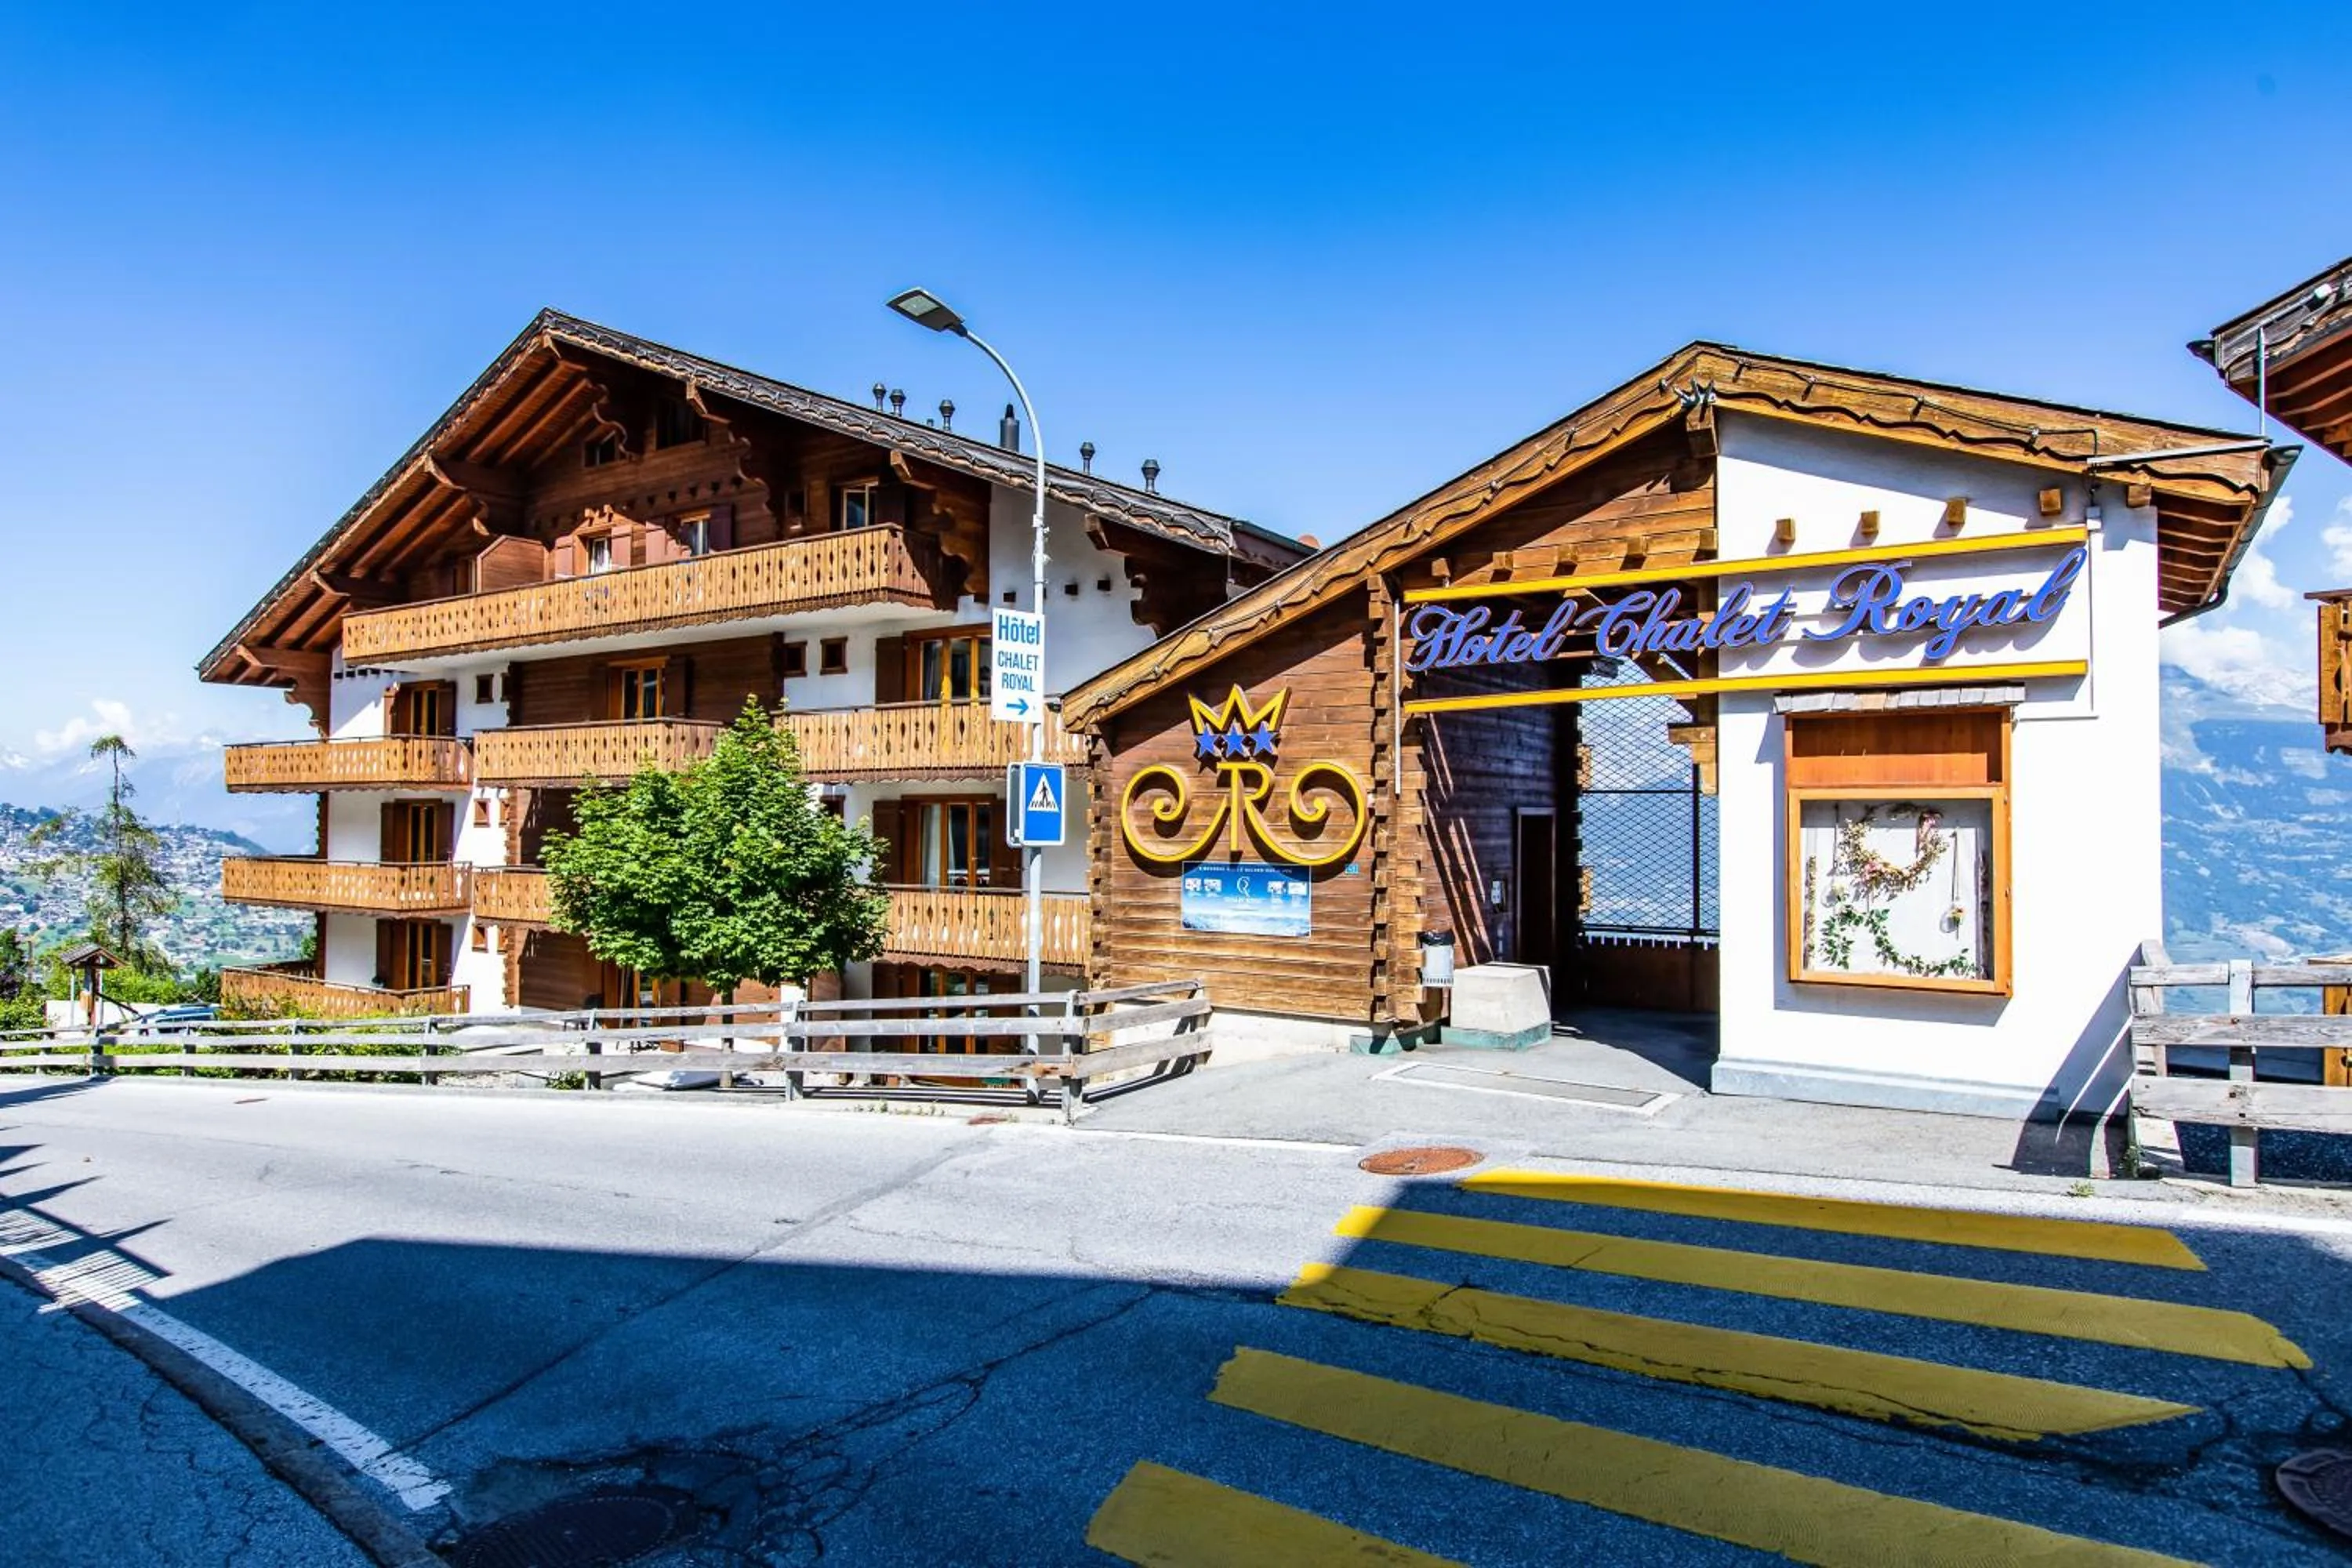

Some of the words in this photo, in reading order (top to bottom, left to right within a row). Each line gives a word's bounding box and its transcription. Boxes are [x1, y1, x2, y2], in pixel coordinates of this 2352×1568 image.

[1404, 598, 1578, 672] Hotel
[1575, 581, 1797, 658] Chalet
[1802, 547, 2087, 659] Royal
[998, 614, 1040, 645] Hôtel
[997, 650, 1040, 672] CHALET
[1001, 672, 1036, 692] ROYAL
